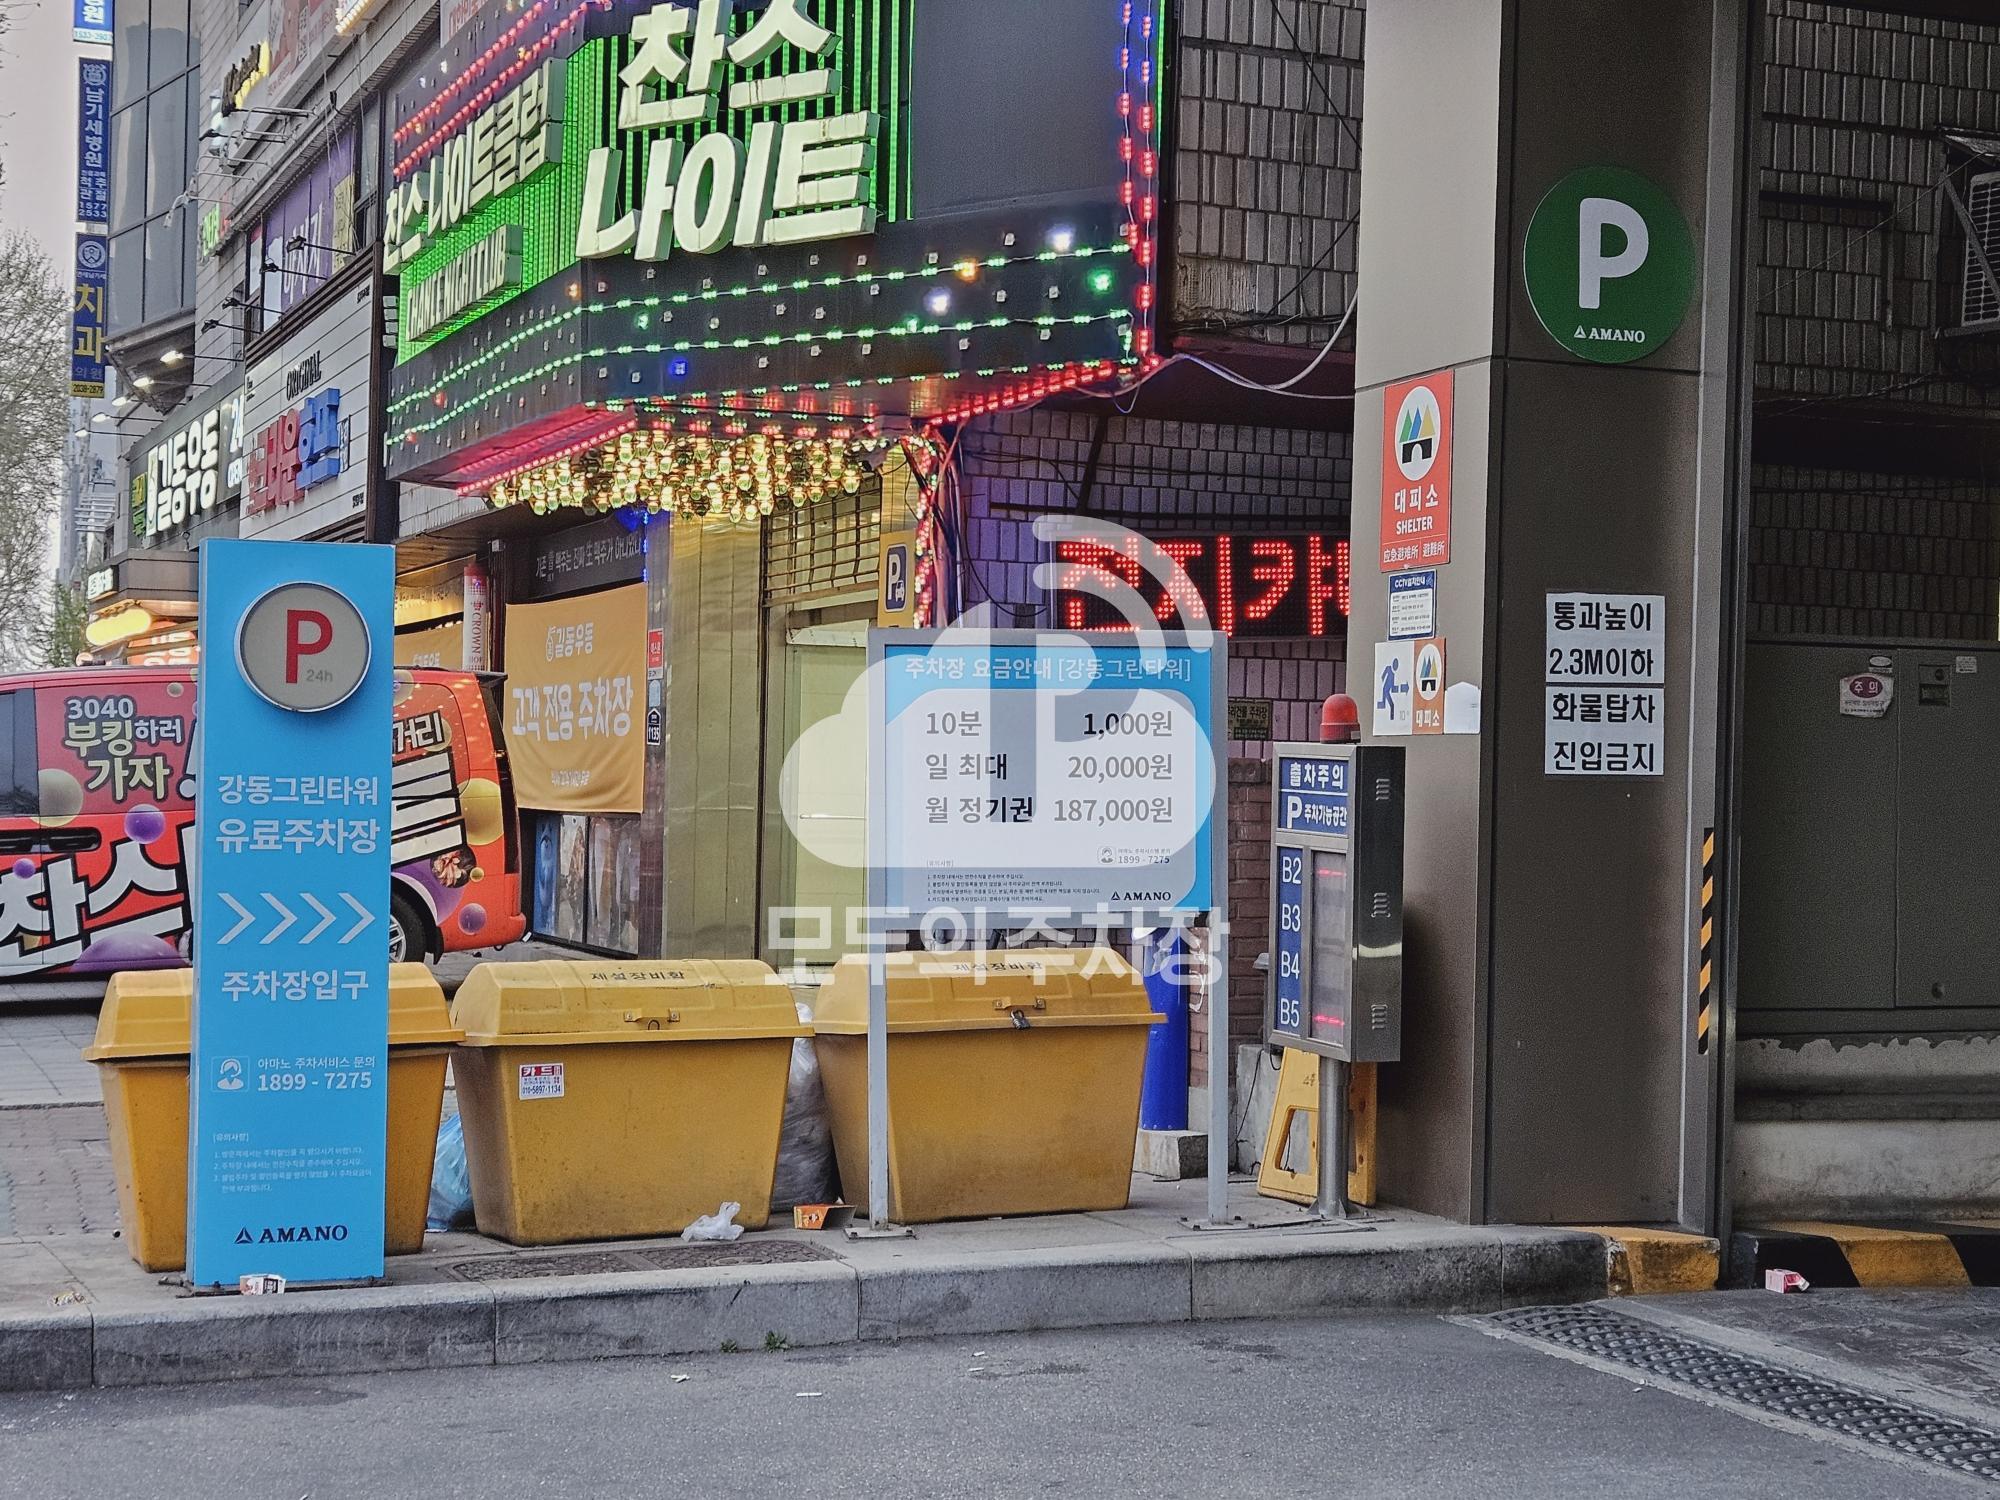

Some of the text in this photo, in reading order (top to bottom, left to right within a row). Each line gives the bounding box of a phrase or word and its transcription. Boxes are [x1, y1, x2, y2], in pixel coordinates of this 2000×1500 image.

[83, 0, 105, 24] 원
[84, 87, 105, 168] 남기세병원
[575, 111, 878, 261] 나이트
[79, 201, 107, 210] 1577
[79, 209, 107, 217] 2533
[1579, 197, 1649, 309] P
[74, 283, 105, 364] 치과
[1589, 327, 1645, 343] AMANO
[286, 350, 322, 401] ORIGINAL
[157, 407, 220, 532] 길동우동
[1394, 484, 1439, 514] 대피소
[1396, 515, 1433, 535] SHELTER
[887, 554, 901, 600] P
[1553, 601, 1651, 631] 통과높이
[285, 609, 333, 684] P
[471, 612, 482, 654] CROWN
[306, 669, 333, 682] 24h
[905, 657, 1191, 682] 주차장 요금안내 [강동그린타워]
[1549, 648, 1654, 677] 2.3M이하
[67, 698, 134, 719] 3040
[512, 675, 633, 741] 고객 전용 주차장
[1416, 709, 1440, 727] 대피소
[1552, 693, 1655, 723] 화물탑차
[65, 718, 182, 757] 부킹하러
[926, 711, 982, 737] 10분
[1083, 711, 1172, 740] 1,000원
[926, 754, 1007, 780] 일 최대
[1068, 754, 1172, 783] 20,000원
[1554, 741, 1654, 772] 진입금지
[1289, 762, 1344, 789] 출차주의
[217, 775, 379, 806] 강동그린타워
[926, 797, 1033, 823] 월 정기권
[1053, 797, 1172, 826] 187,000원
[1286, 796, 1348, 828] P 주차가능공간
[216, 818, 380, 855] 유료주차장
[1148, 855, 1171, 864] 7275
[1282, 857, 1302, 884] B2
[1124, 891, 1171, 901] AMANO
[1281, 904, 1301, 933] B3
[591, 970, 685, 981] 제설장비함
[1281, 950, 1300, 979] B4
[222, 970, 369, 1002] 주차장입구
[1280, 998, 1300, 1027] B5
[258, 1056, 376, 1070] 아마노 주차서비스 문의
[258, 1073, 306, 1091] 1899
[324, 1071, 372, 1089] 7275
[258, 1225, 348, 1244] AMANO
